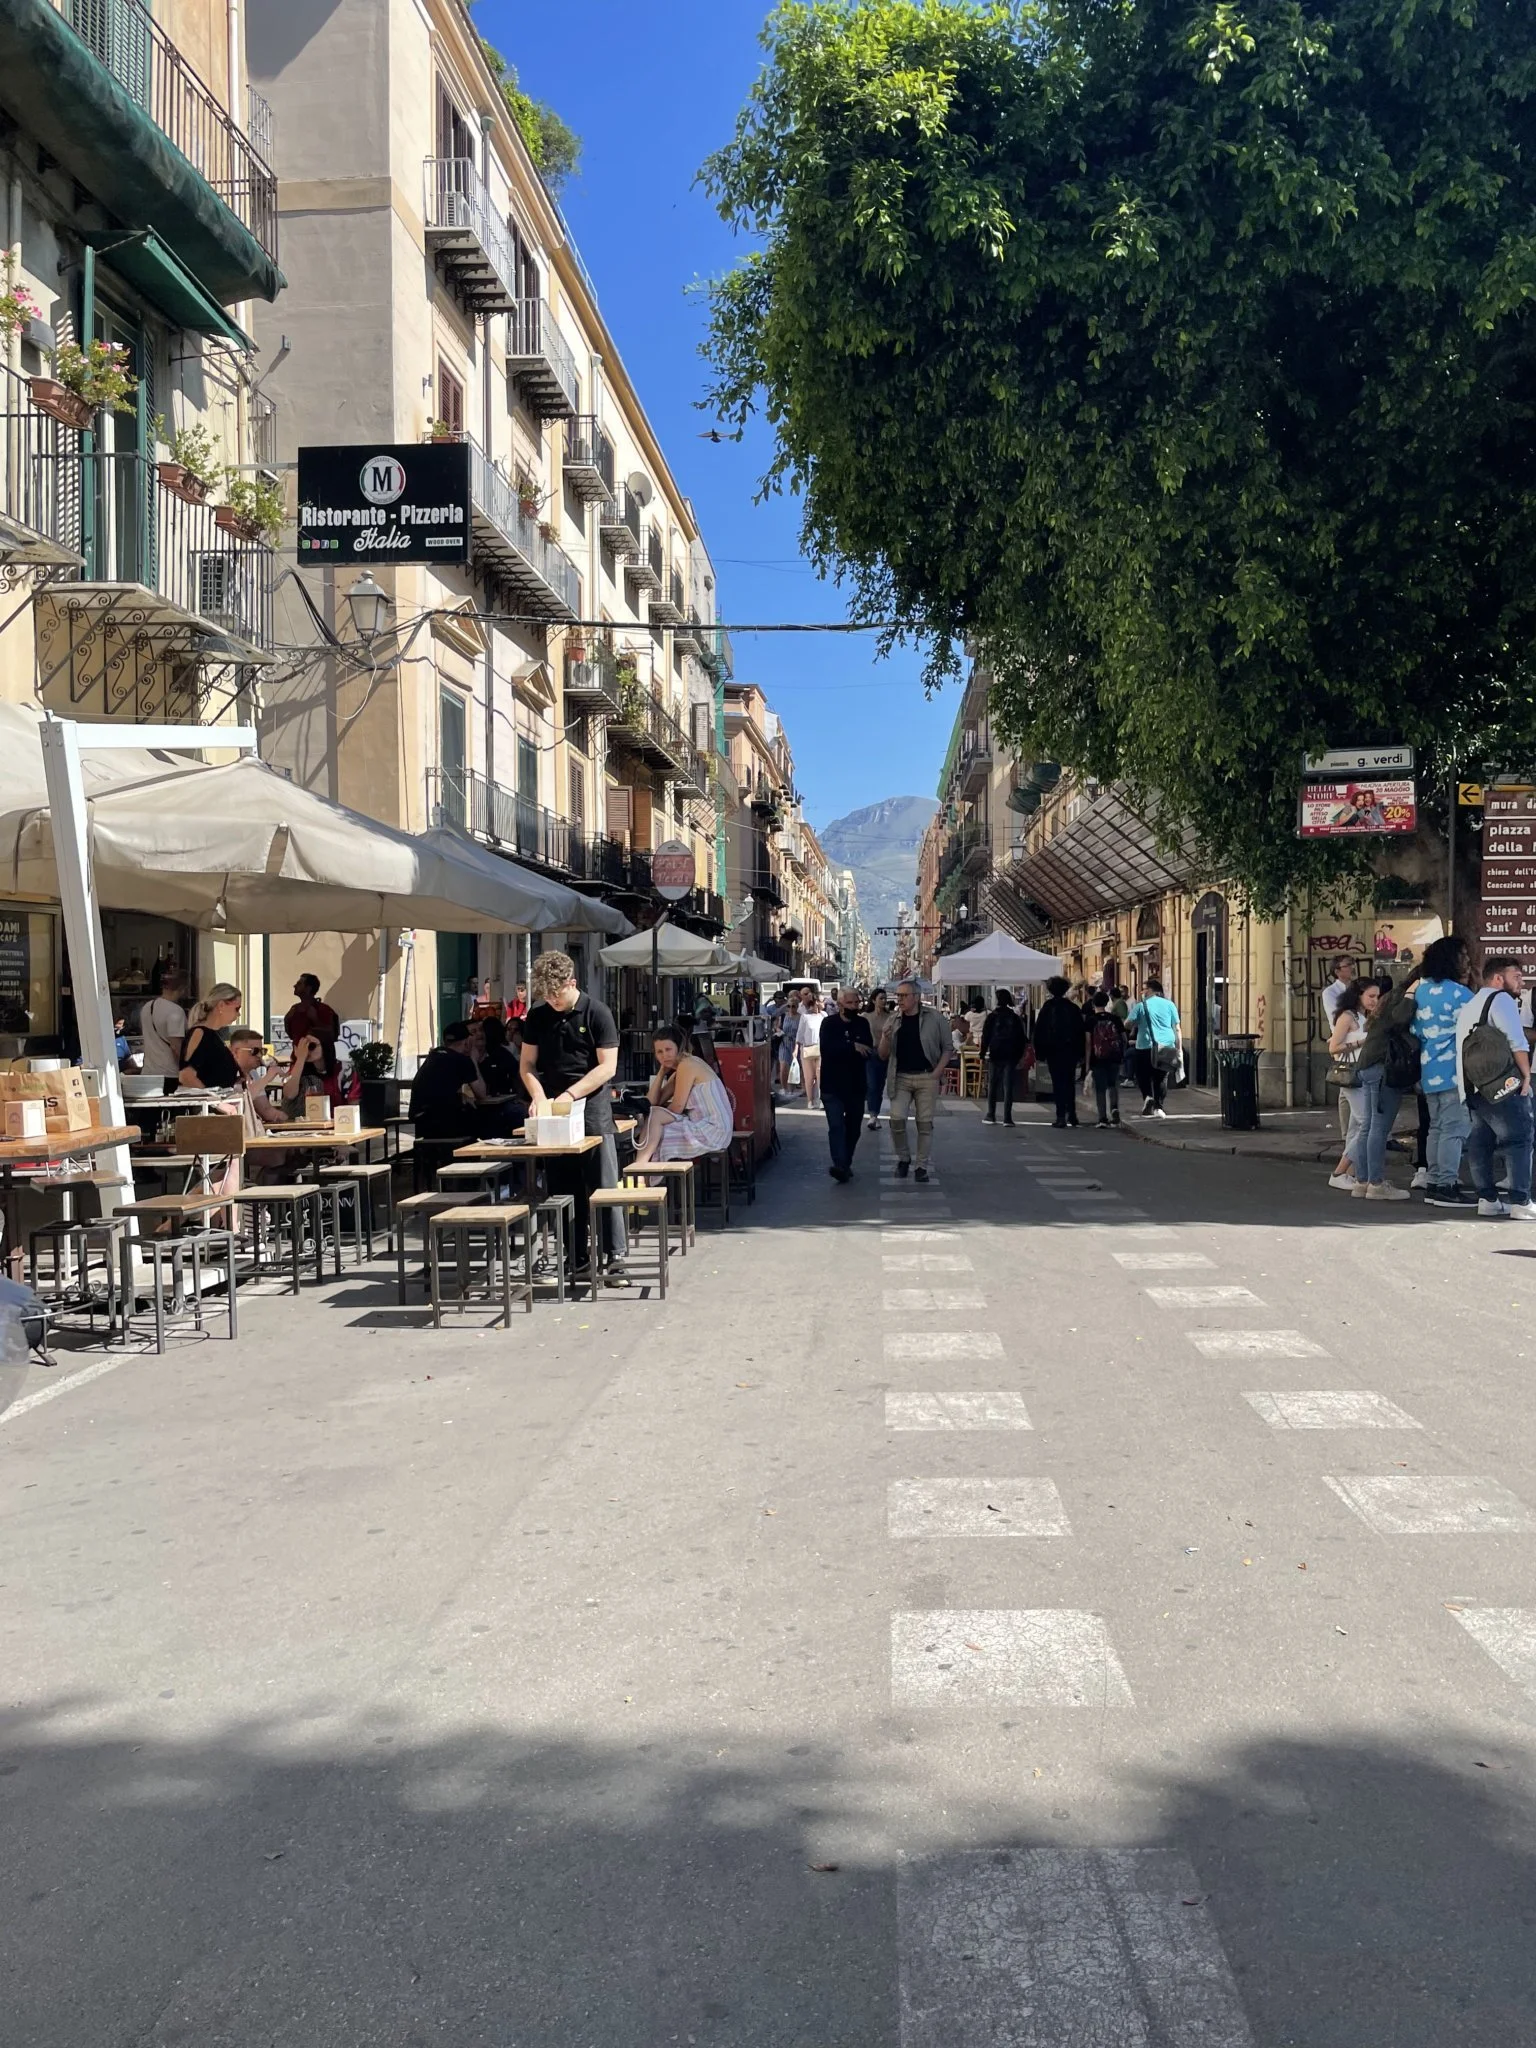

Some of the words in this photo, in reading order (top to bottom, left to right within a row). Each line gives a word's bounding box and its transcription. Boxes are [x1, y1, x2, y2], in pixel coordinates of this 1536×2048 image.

[372, 466, 393, 492] M
[302, 506, 386, 527] Ristorante
[401, 504, 463, 525] Pizzeria
[353, 525, 412, 552] Italia
[1373, 753, 1403, 764] verdi
[1307, 792, 1333, 800] STORE
[1491, 801, 1518, 810] mura
[1384, 806, 1411, 819] -20%
[1489, 824, 1531, 837] piazza
[1488, 842, 1523, 853] della
[1487, 868, 1509, 876] chiesa
[1485, 905, 1518, 916] chiesa
[1526, 905, 1536, 916] di
[1485, 922, 1513, 933] Sant'
[1485, 945, 1536, 955] mercato
